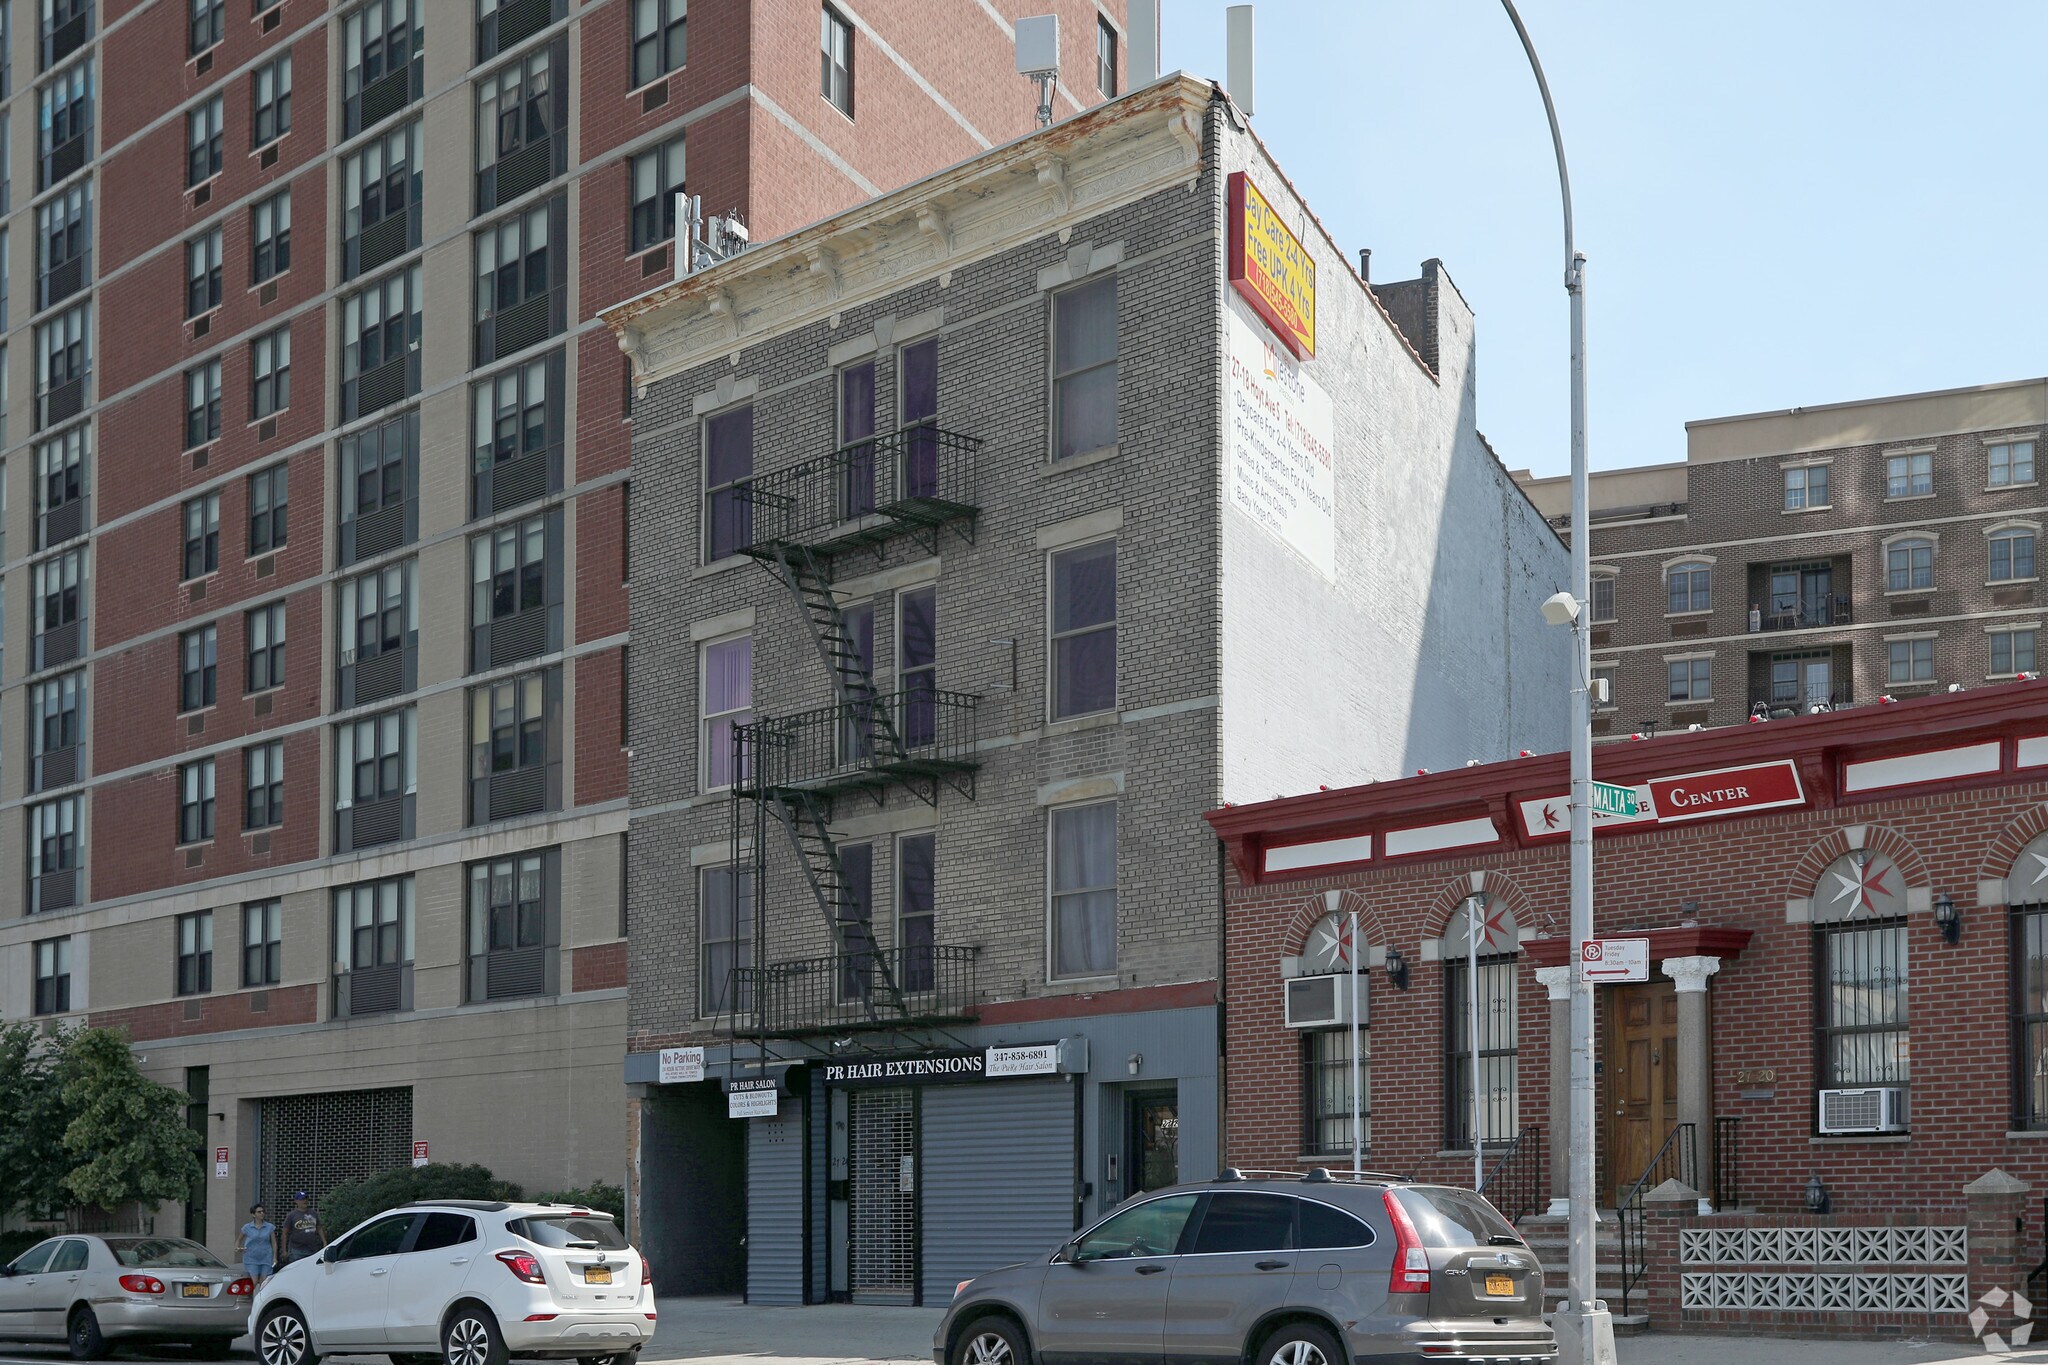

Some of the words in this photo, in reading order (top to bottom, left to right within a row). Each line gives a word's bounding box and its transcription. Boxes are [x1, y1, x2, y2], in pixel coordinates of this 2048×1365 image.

[1245, 181, 1261, 230] Day
[1264, 207, 1283, 252] Care
[1286, 236, 1298, 270] 2-4
[1300, 251, 1313, 288] Yrs
[1248, 223, 1267, 268] Free
[1270, 248, 1288, 294] UPK
[1290, 276, 1296, 302] 4
[1297, 281, 1310, 320] Yrs
[1256, 265, 1298, 328] (718)545-5580
[1232, 356, 1250, 390] 27-18
[1250, 374, 1264, 408] Hoyt
[1266, 390, 1276, 417] Ave
[1277, 401, 1280, 421] S
[1237, 390, 1264, 430] Daycare
[1265, 418, 1275, 440] For
[1287, 438, 1303, 468] Years
[1304, 455, 1314, 478] Old
[1237, 416, 1290, 480] Pre-Kindergarten
[1290, 467, 1300, 488] For
[1306, 481, 1321, 508] Years
[1322, 496, 1331, 517] Old
[1237, 444, 1254, 470] Gifted
[1256, 460, 1260, 474] &
[1262, 466, 1284, 496] Talented
[1285, 487, 1297, 510] Prep
[1237, 464, 1254, 490] Music
[1255, 480, 1259, 494] &
[1260, 486, 1272, 506] Arts
[1273, 496, 1288, 519] Class
[1237, 486, 1252, 512] Baby
[1253, 498, 1266, 522] Yoga
[1267, 512, 1282, 534] Class
[1594, 786, 1626, 813] MALTA
[1627, 793, 1635, 804] SQ
[662, 1052, 672, 1064] No
[674, 1051, 700, 1065] Parking
[826, 1066, 844, 1080] PR
[847, 1064, 883, 1078] HAIR
[885, 1056, 982, 1076] EXTENSIONS
[988, 1064, 1000, 1072] The
[1018, 1062, 1034, 1071] Hair
[1034, 1060, 1052, 1070] Salon
[994, 1050, 1048, 1062] 347-858-6891
[730, 1082, 738, 1090] PR
[739, 1081, 755, 1090] HAIR
[755, 1079, 776, 1089] SALON
